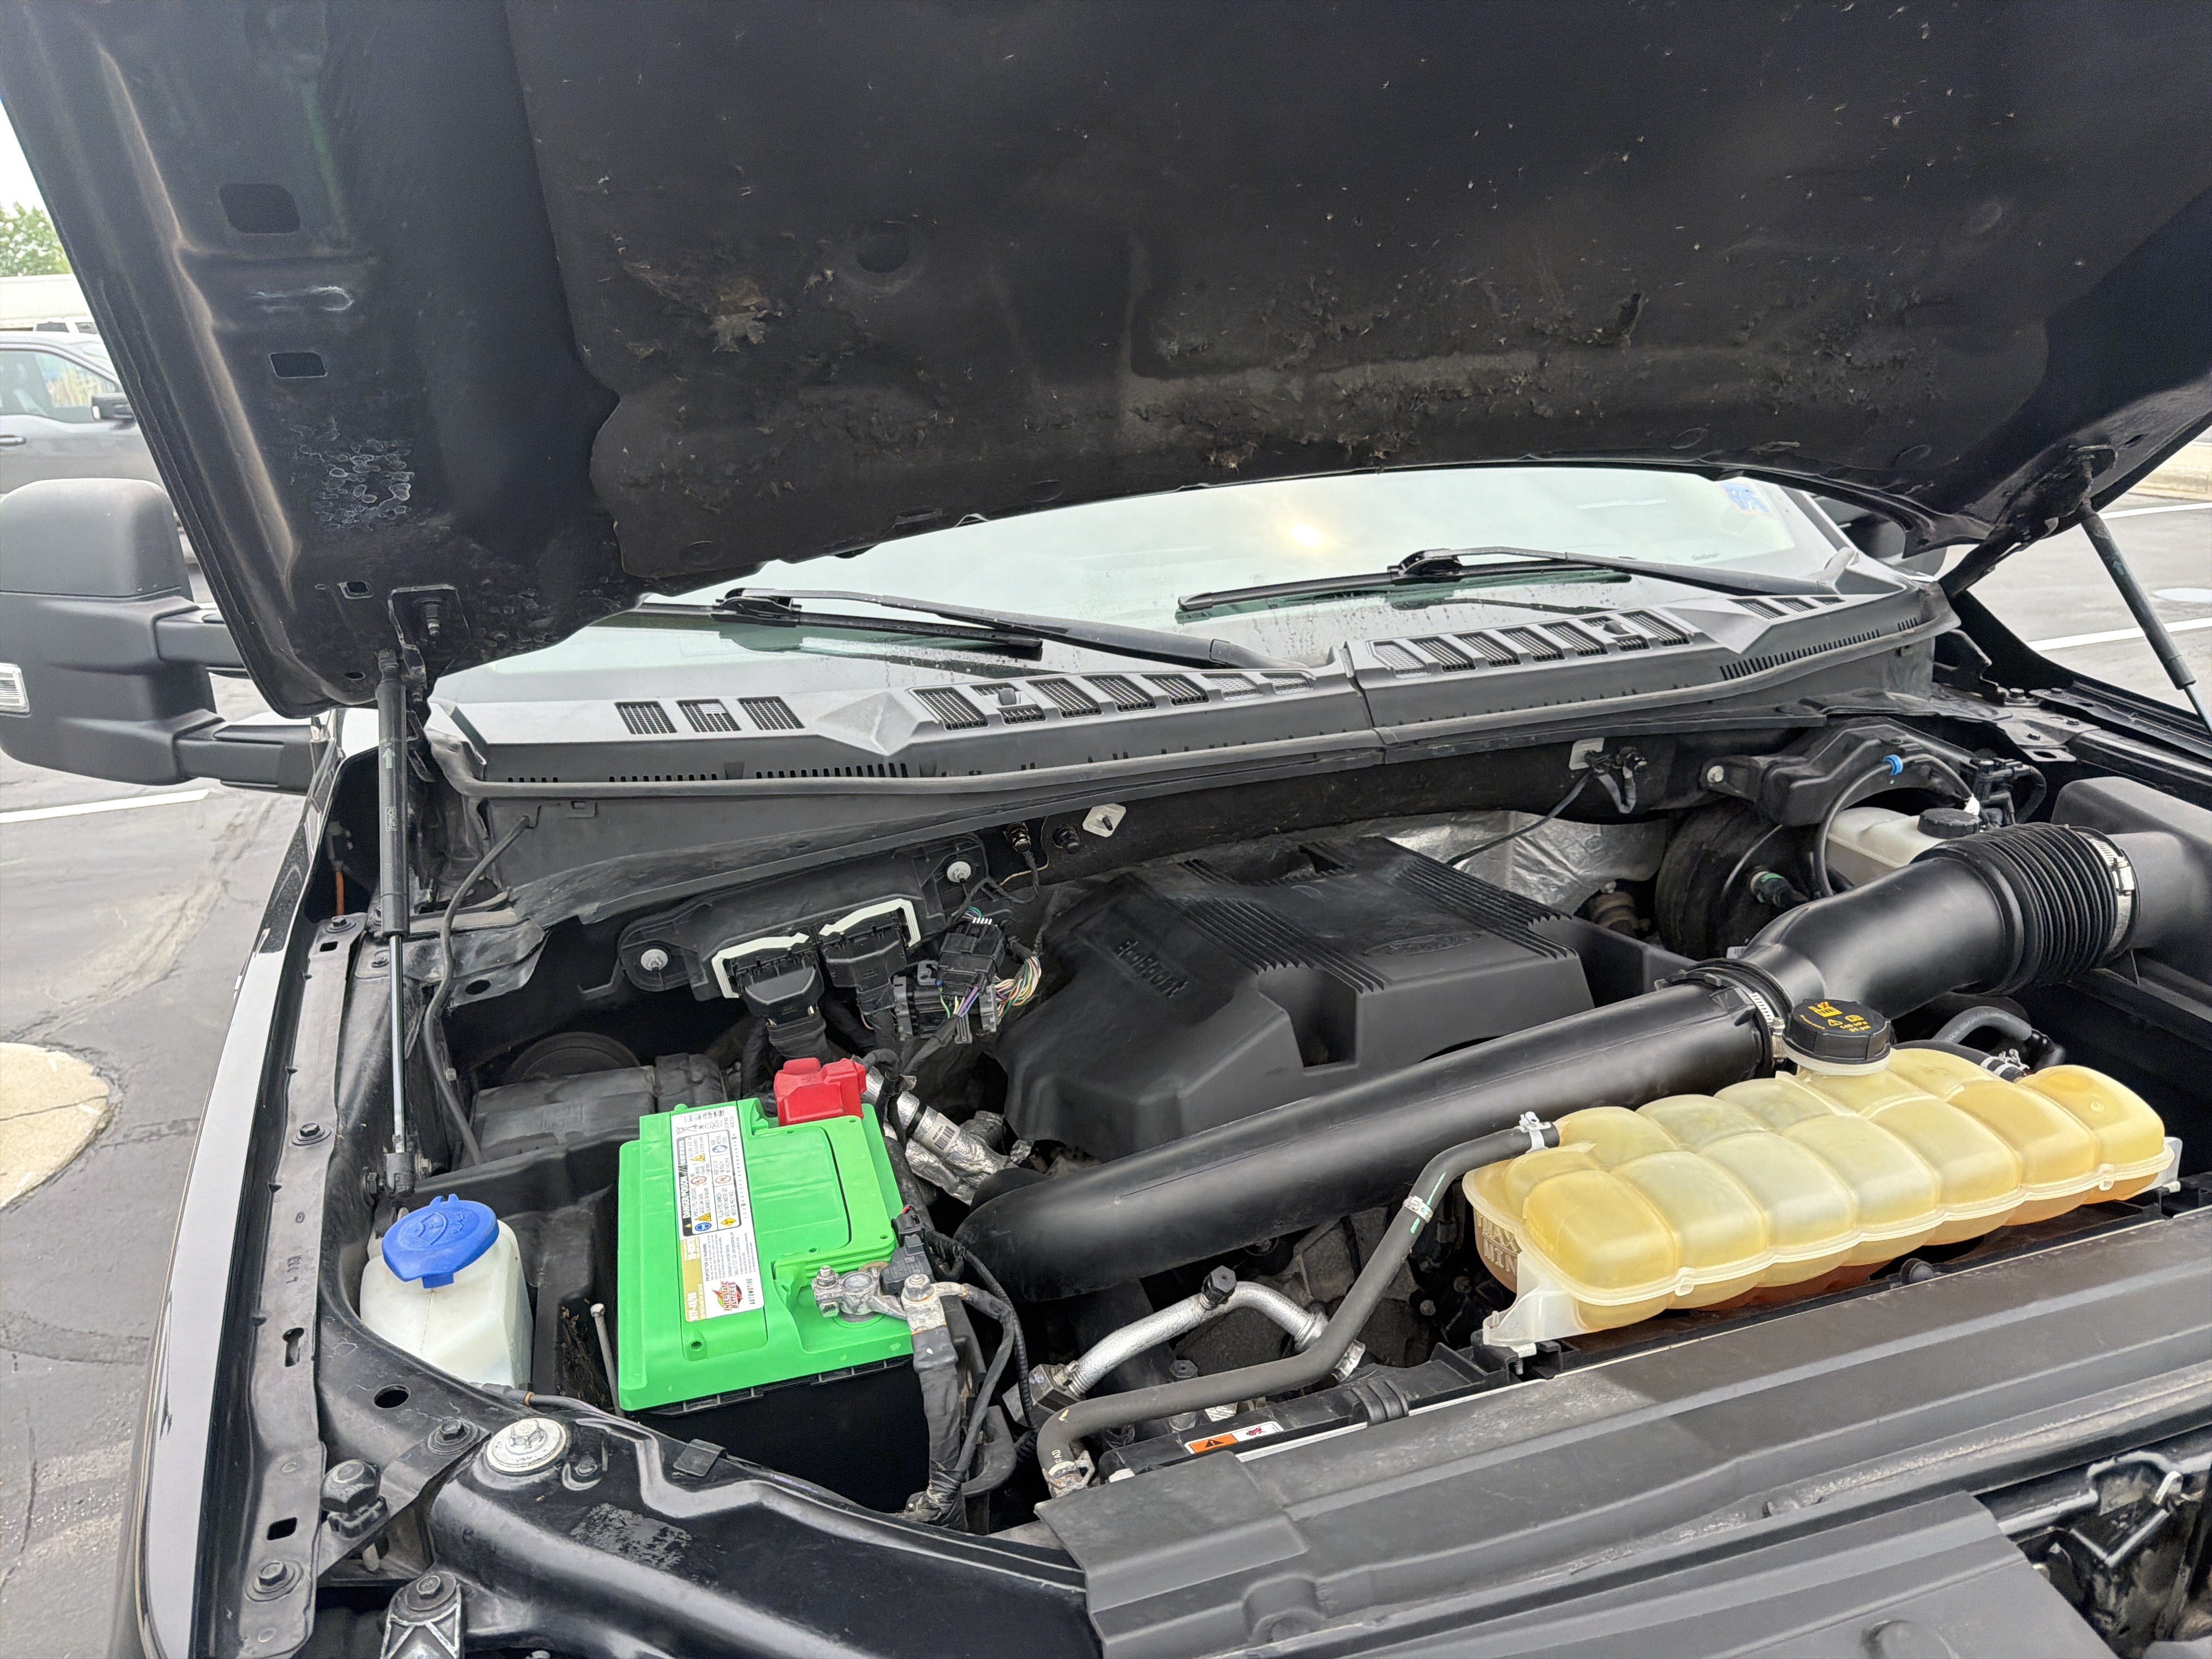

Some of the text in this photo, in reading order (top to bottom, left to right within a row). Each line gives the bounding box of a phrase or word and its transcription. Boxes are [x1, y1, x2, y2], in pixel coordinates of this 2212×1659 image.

[679, 1175, 691, 1218] DANGER/POISON
[1483, 1238, 1517, 1276] MIN
[721, 1280, 730, 1311] INTERSTATE
[729, 1281, 737, 1308] BATTERIES
[746, 1278, 755, 1305] AUTOMOTIVE
